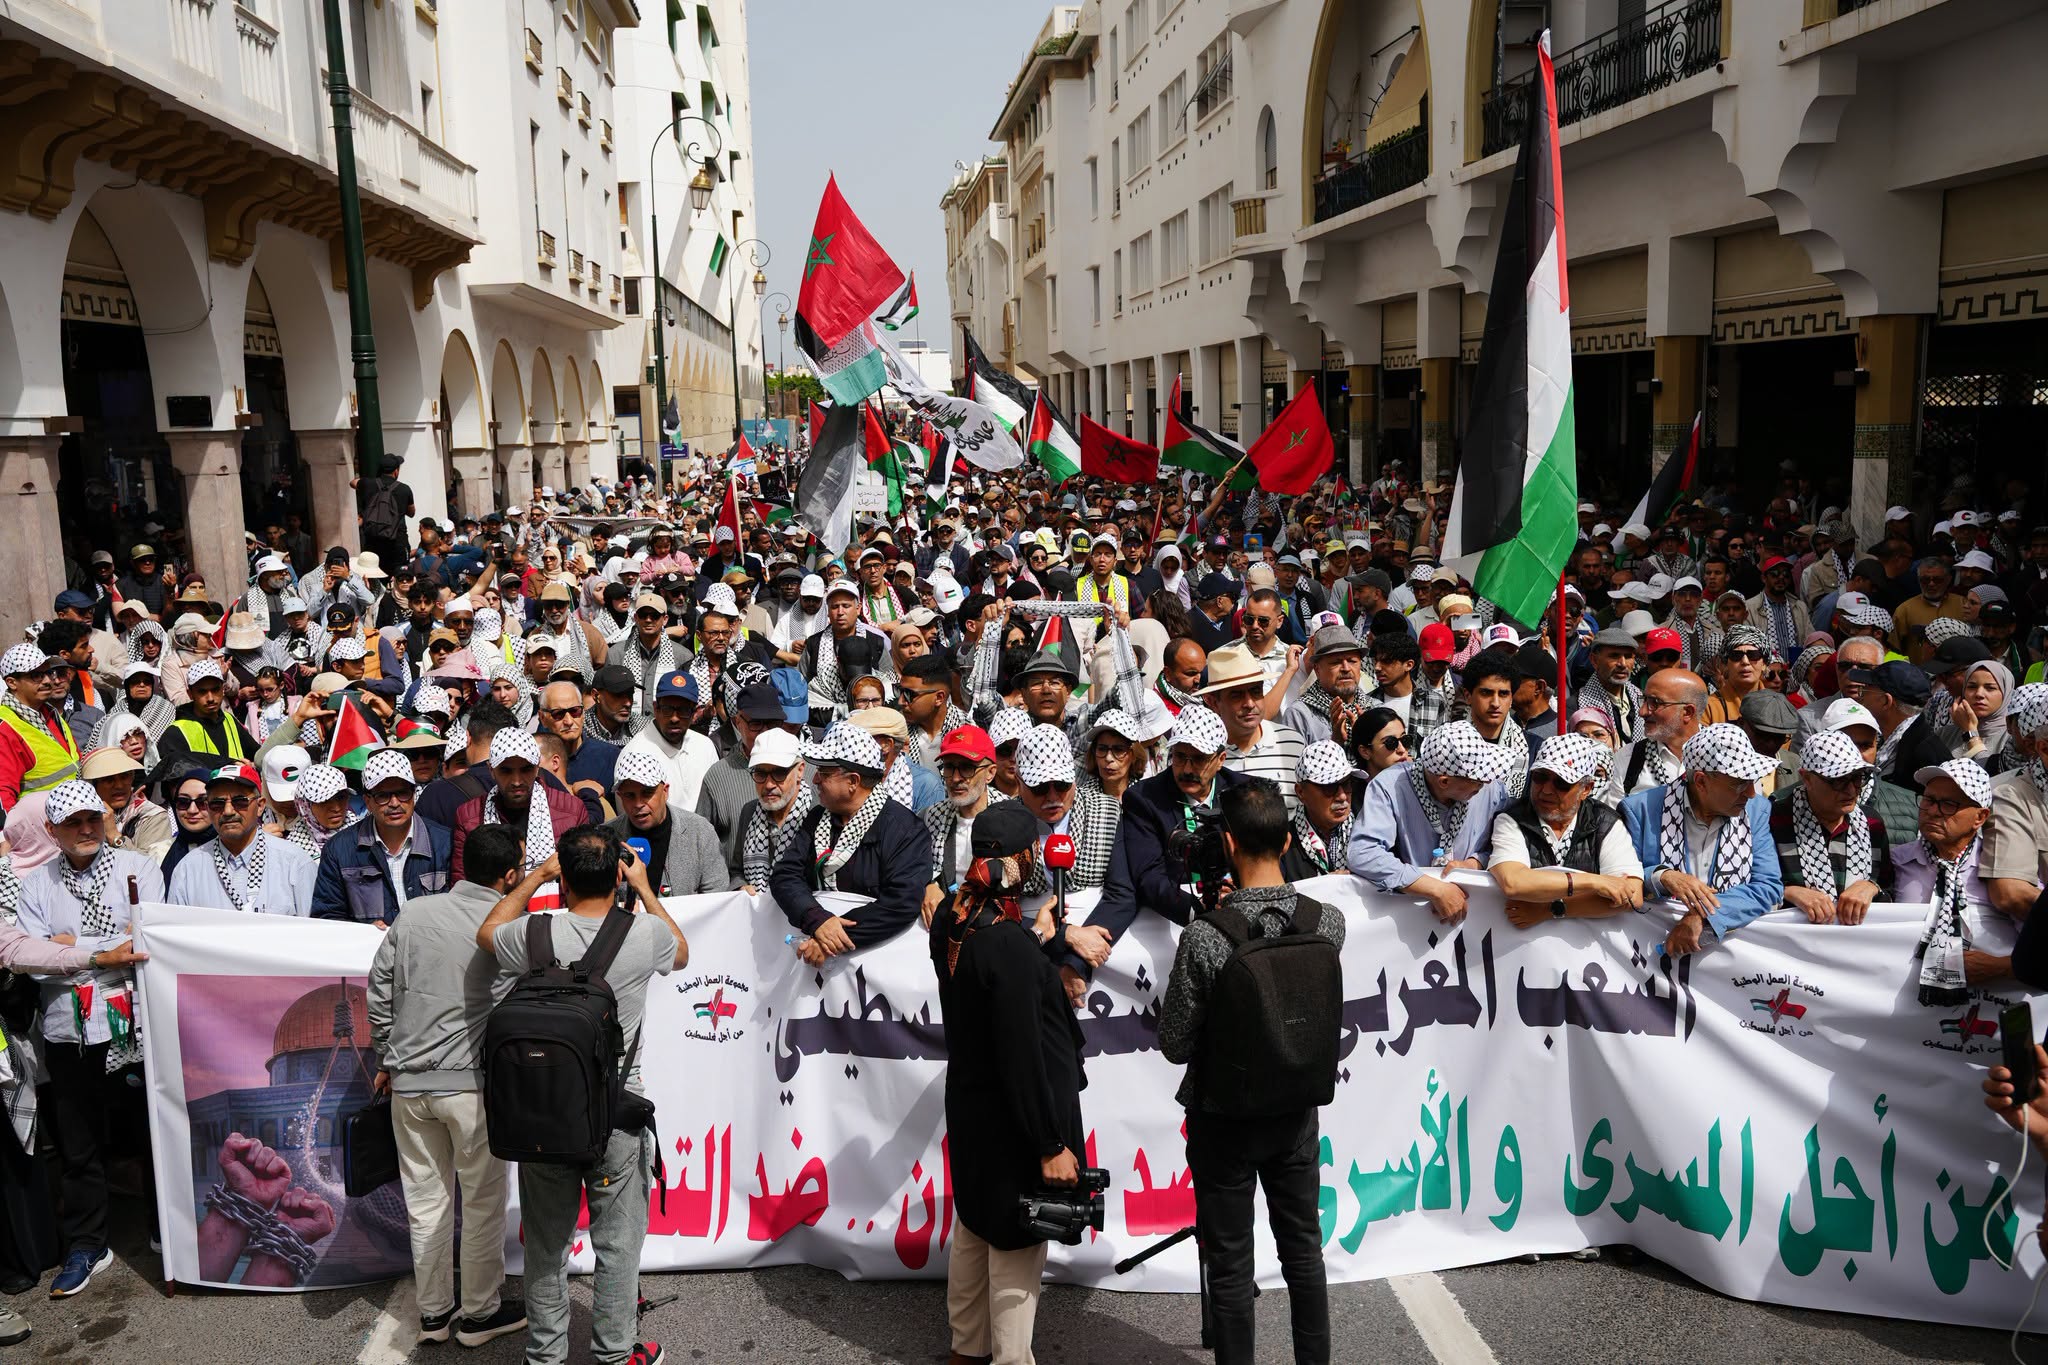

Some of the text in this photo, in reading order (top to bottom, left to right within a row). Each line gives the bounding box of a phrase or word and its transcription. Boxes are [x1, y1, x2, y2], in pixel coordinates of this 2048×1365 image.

[676, 974, 749, 994] مجموعة العمل الوطنية
[1516, 939, 1696, 1050] الشعب
[1731, 973, 1765, 988] الوطنية
[1766, 973, 1791, 986] العمل
[684, 1028, 744, 1043] من أجل فلسطين
[747, 1126, 829, 1243] ضد
[1488, 1124, 1523, 1232] و
[1563, 1116, 1755, 1247] المسرى
[1778, 1093, 1898, 1282] أجل
[1924, 1168, 2020, 1295] من
